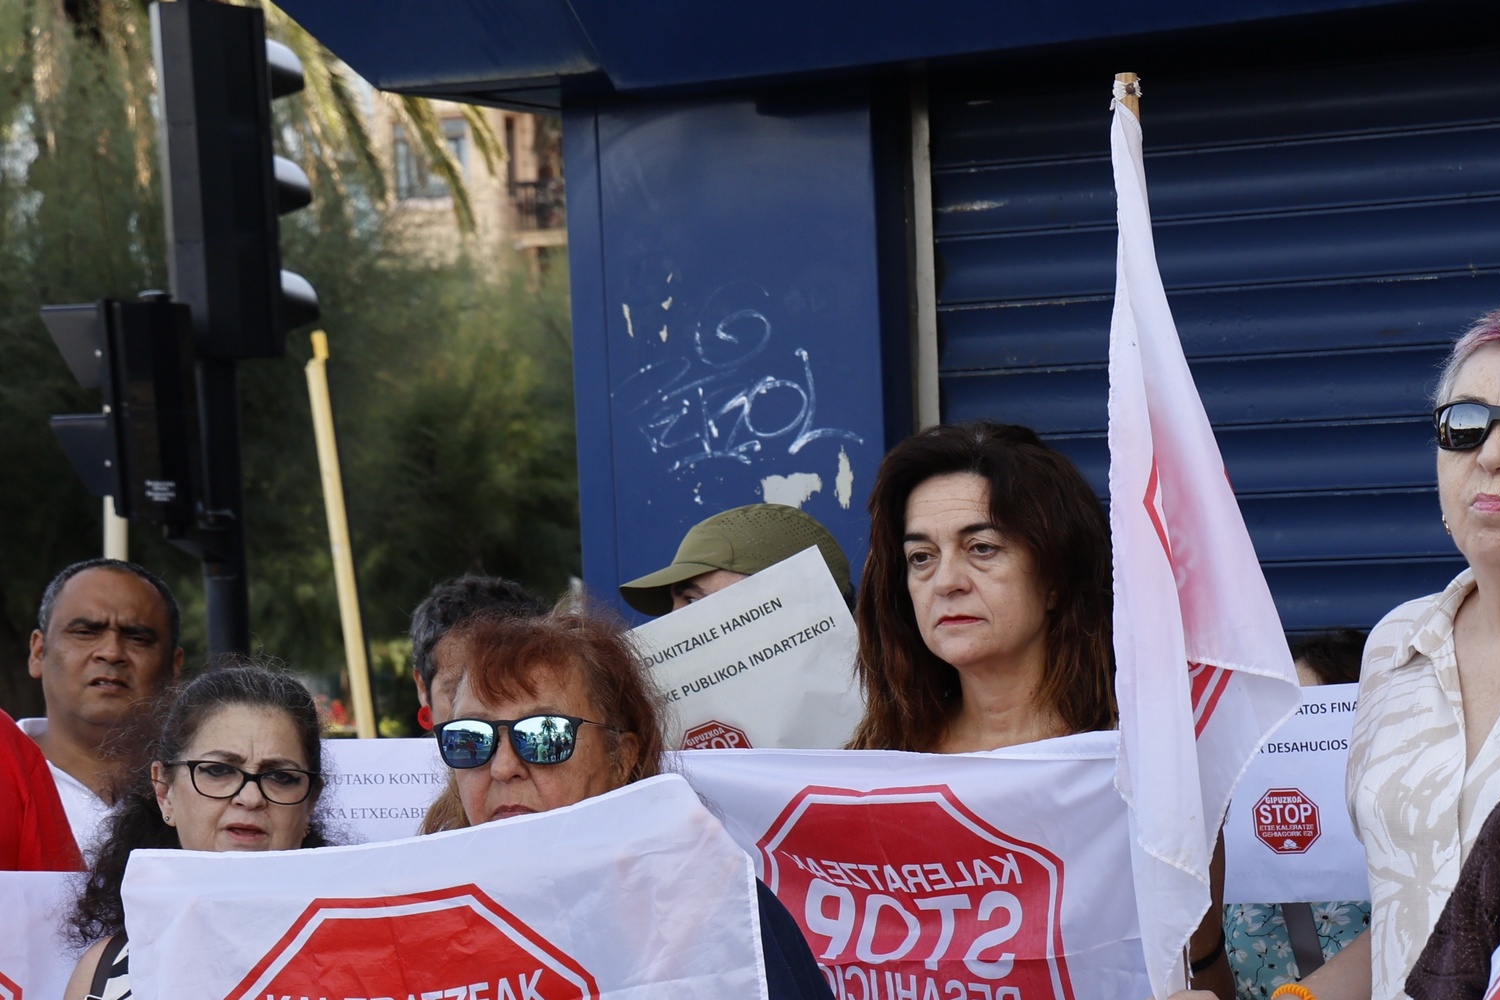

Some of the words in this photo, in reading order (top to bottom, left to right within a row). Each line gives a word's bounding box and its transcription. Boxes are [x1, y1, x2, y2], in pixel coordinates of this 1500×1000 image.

[643, 627, 720, 669] DUKITZAILE
[720, 597, 783, 635] HANDIEN
[681, 660, 748, 697] PUBLIKOA
[748, 616, 836, 667] INDARTZEKO!
[1295, 703, 1327, 715] ATOS
[686, 727, 726, 747] GIPUZKOA
[1267, 739, 1348, 754] DESAHUCIOS
[333, 773, 385, 786] UTAKO
[389, 773, 440, 785] KONTR
[1264, 795, 1303, 804] GIPUZKOA
[350, 807, 428, 819] ETXEGABE
[1259, 803, 1312, 824] STOP
